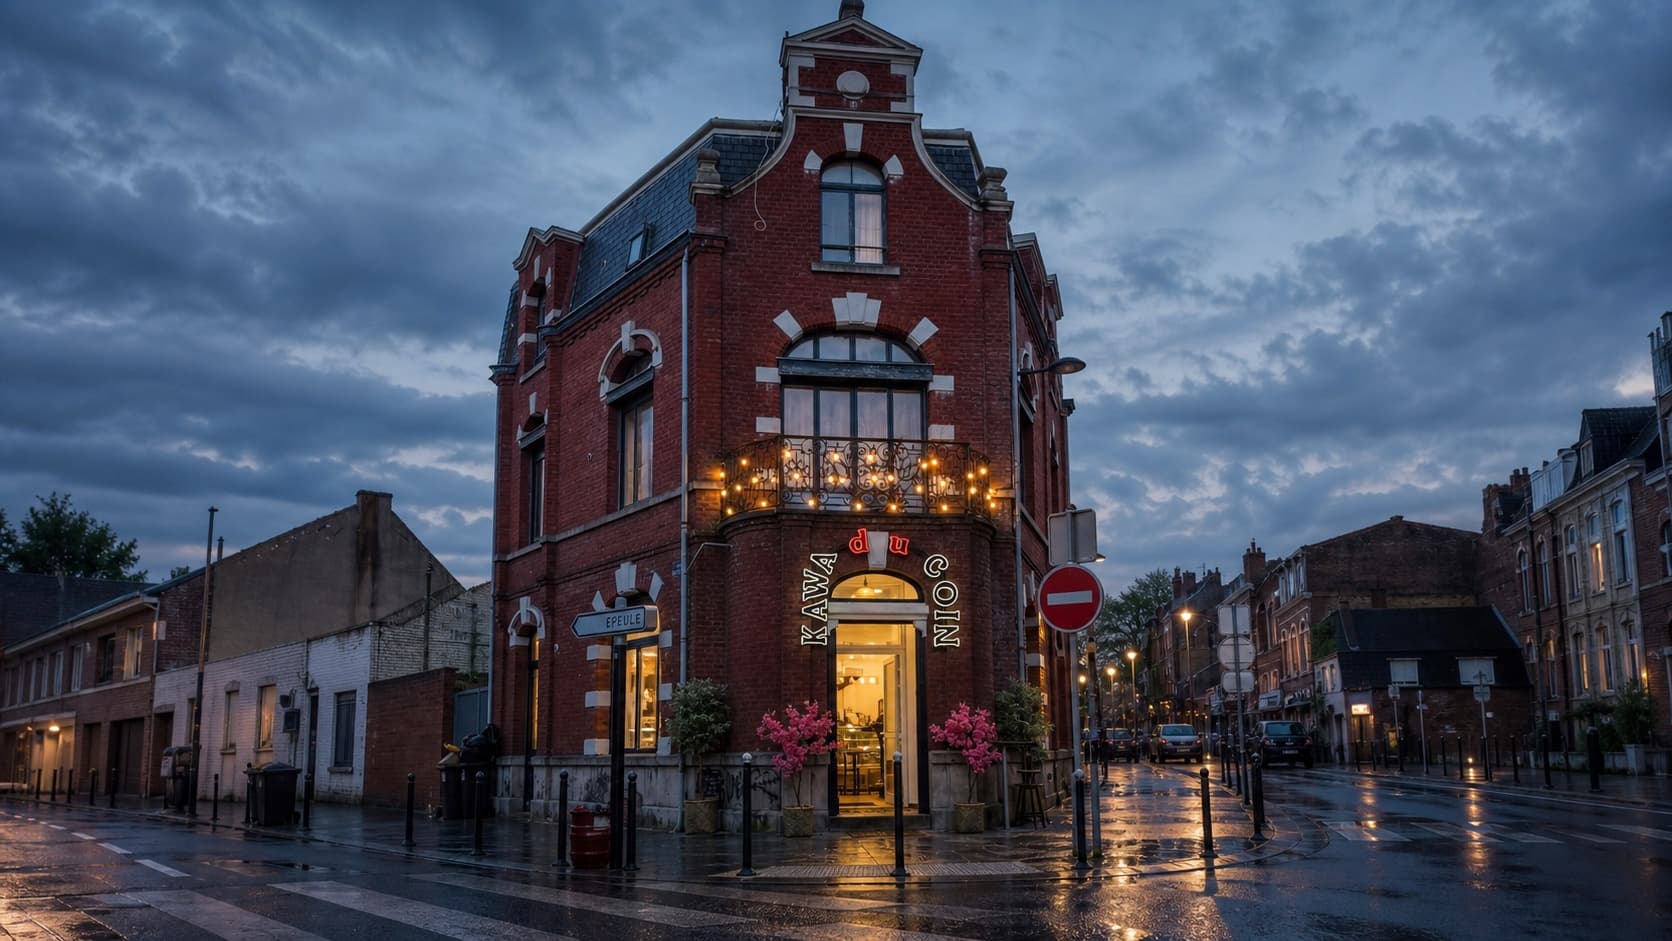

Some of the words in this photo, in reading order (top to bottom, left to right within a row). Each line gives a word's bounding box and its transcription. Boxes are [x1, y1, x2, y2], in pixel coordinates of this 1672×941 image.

[606, 613, 641, 628] EPEULE
[801, 553, 838, 646] KAWA
[849, 528, 910, 555] du
[924, 553, 960, 648] COIN
